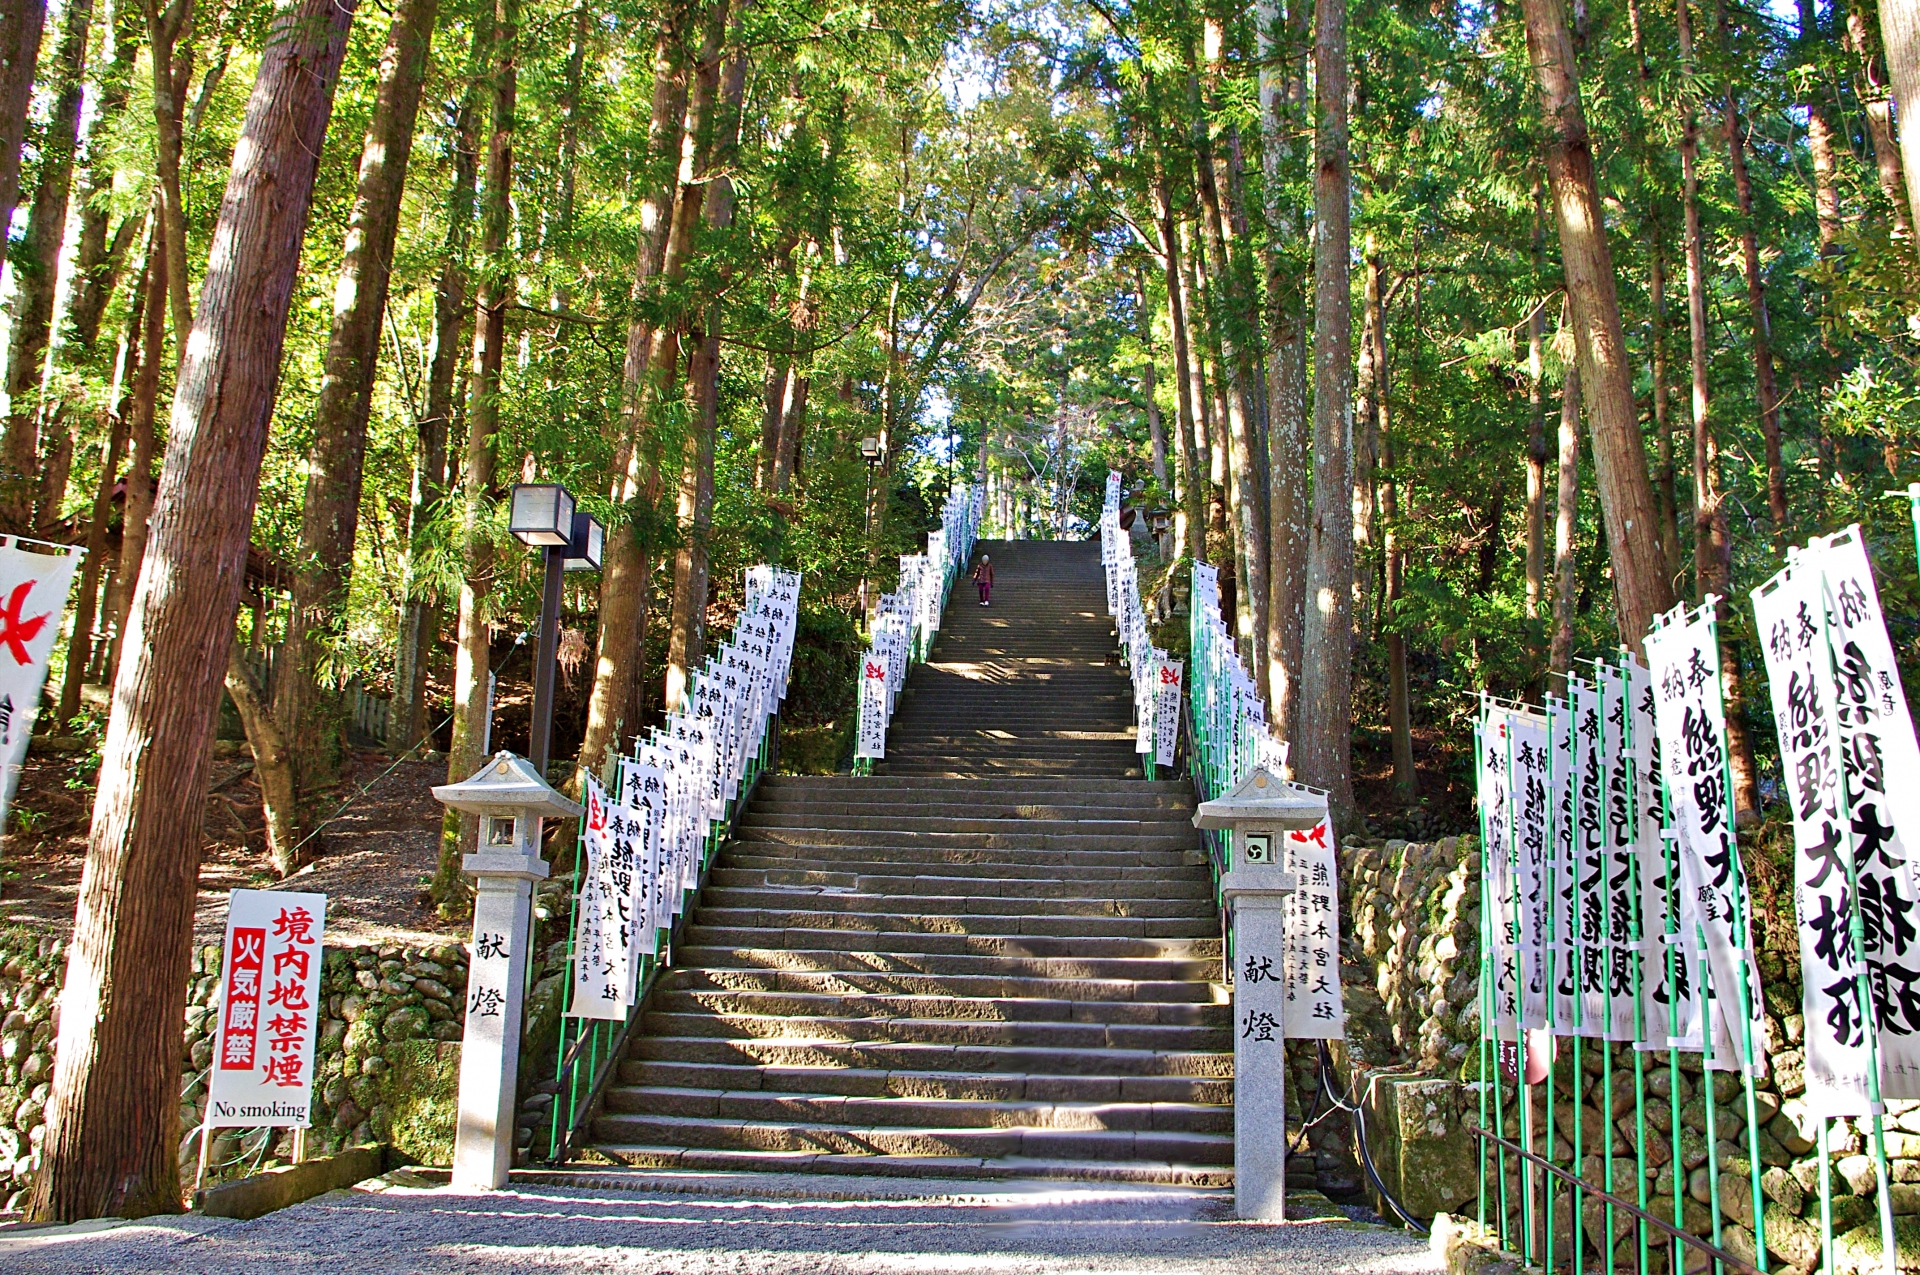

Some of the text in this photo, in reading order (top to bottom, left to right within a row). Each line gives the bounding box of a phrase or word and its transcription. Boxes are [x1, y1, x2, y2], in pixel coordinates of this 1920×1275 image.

[1771, 600, 1818, 663] 奉納
[1662, 648, 1713, 702] 奉納
[1697, 884, 1720, 922] 願主
[225, 933, 259, 1064] 火気厳禁
[262, 907, 315, 1087] 境内地禁煙
[470, 933, 510, 1017] 献燈
[1243, 956, 1281, 1042] 献燈
[214, 1100, 306, 1121] No smoking
